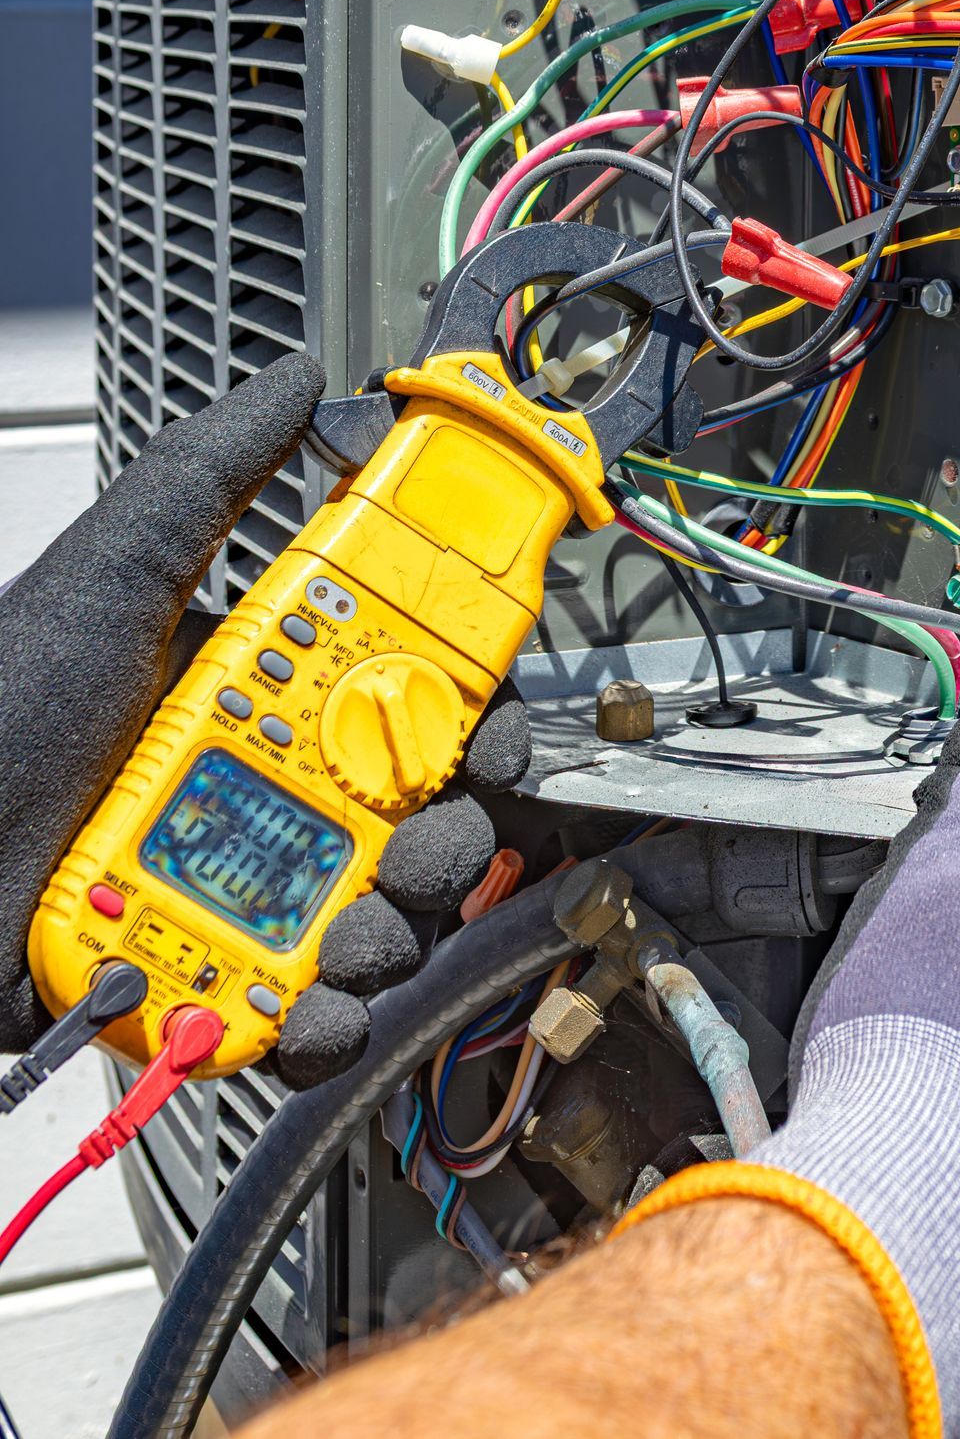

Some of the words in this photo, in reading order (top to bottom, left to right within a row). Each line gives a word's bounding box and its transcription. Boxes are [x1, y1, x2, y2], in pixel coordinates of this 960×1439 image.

[468, 372, 489, 389] 600V
[549, 428, 569, 446] 400A
[333, 643, 355, 661] MFD
[249, 671, 283, 698] RANGE
[210, 710, 239, 734] HOLD
[245, 733, 287, 764] MAX/MIN
[298, 760, 318, 776] OFF
[103, 871, 139, 897] SELECT
[78, 932, 105, 954] COM
[219, 957, 241, 974] TEMP
[252, 966, 291, 994] Hz/Duty
